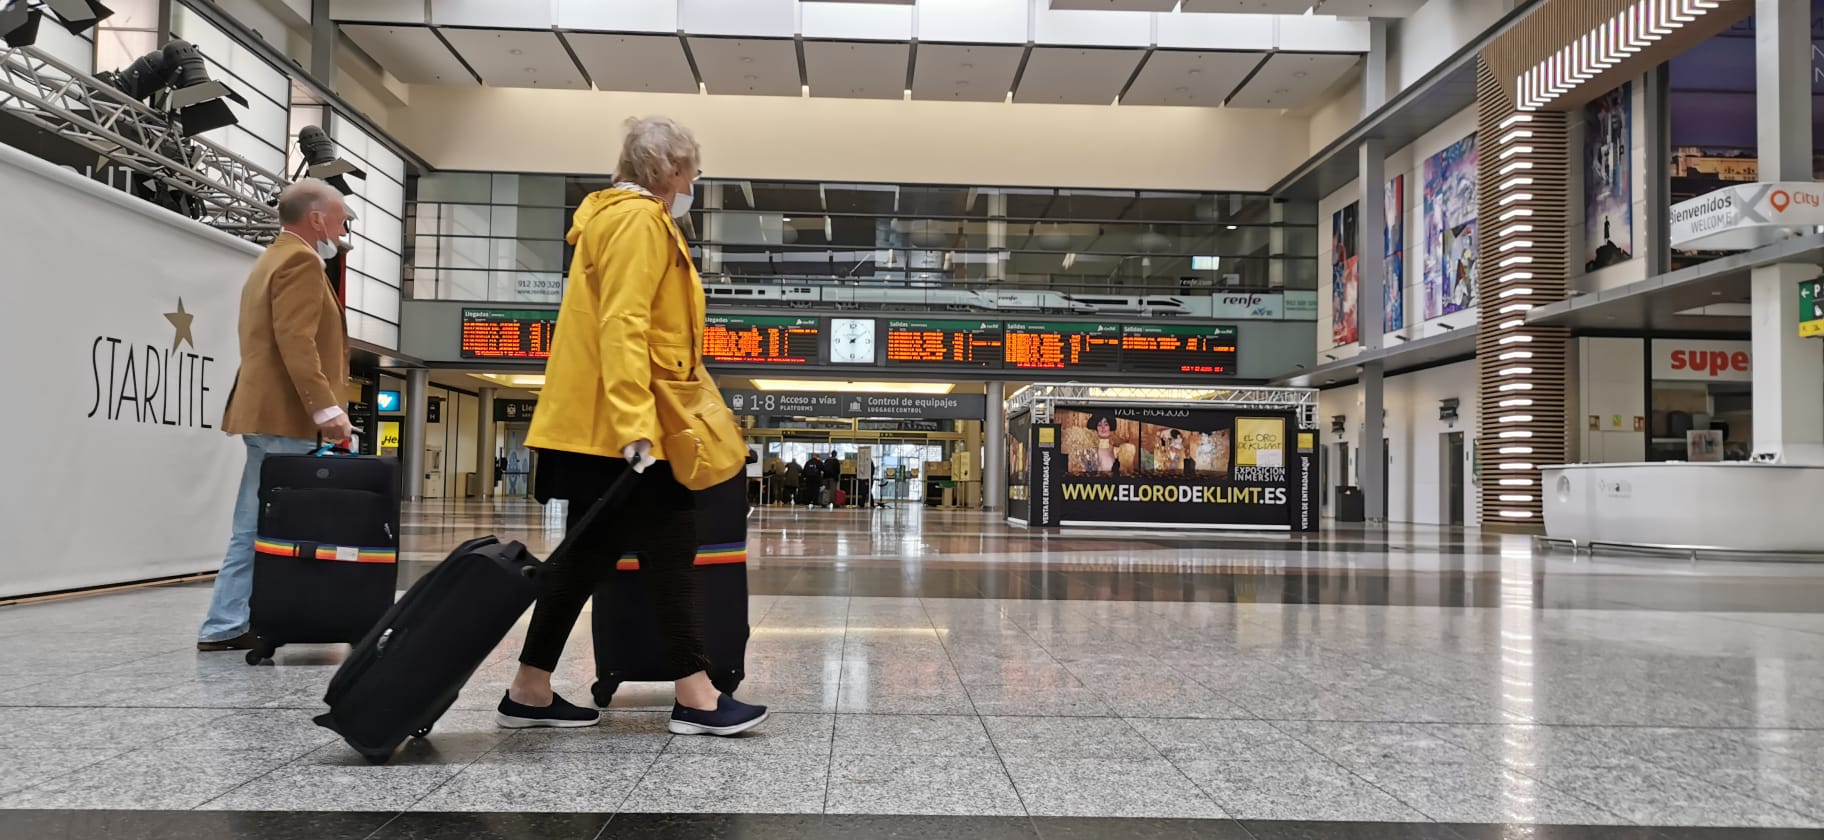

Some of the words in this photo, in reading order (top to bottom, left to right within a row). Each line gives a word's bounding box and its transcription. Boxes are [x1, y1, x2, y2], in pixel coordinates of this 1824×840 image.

[1793, 191, 1820, 208] City
[1691, 211, 1732, 234] WELCOME
[1223, 293, 1262, 308] renfe
[87, 335, 214, 429] STARLITE
[750, 394, 775, 411] 1-8
[780, 395, 809, 405] Acceso
[810, 397, 817, 405] a
[818, 395, 837, 405] vías
[867, 396, 899, 406] Control
[901, 396, 913, 406] de
[915, 397, 958, 409] equipajes
[1042, 466, 1050, 496] ENTRADAS
[1234, 474, 1286, 482] INMERSIVA
[1301, 472, 1309, 502] ENTRADAS
[1061, 483, 1287, 505] WWW.ELORODEKLIMT.ES
[1042, 505, 1050, 525] VENTA
